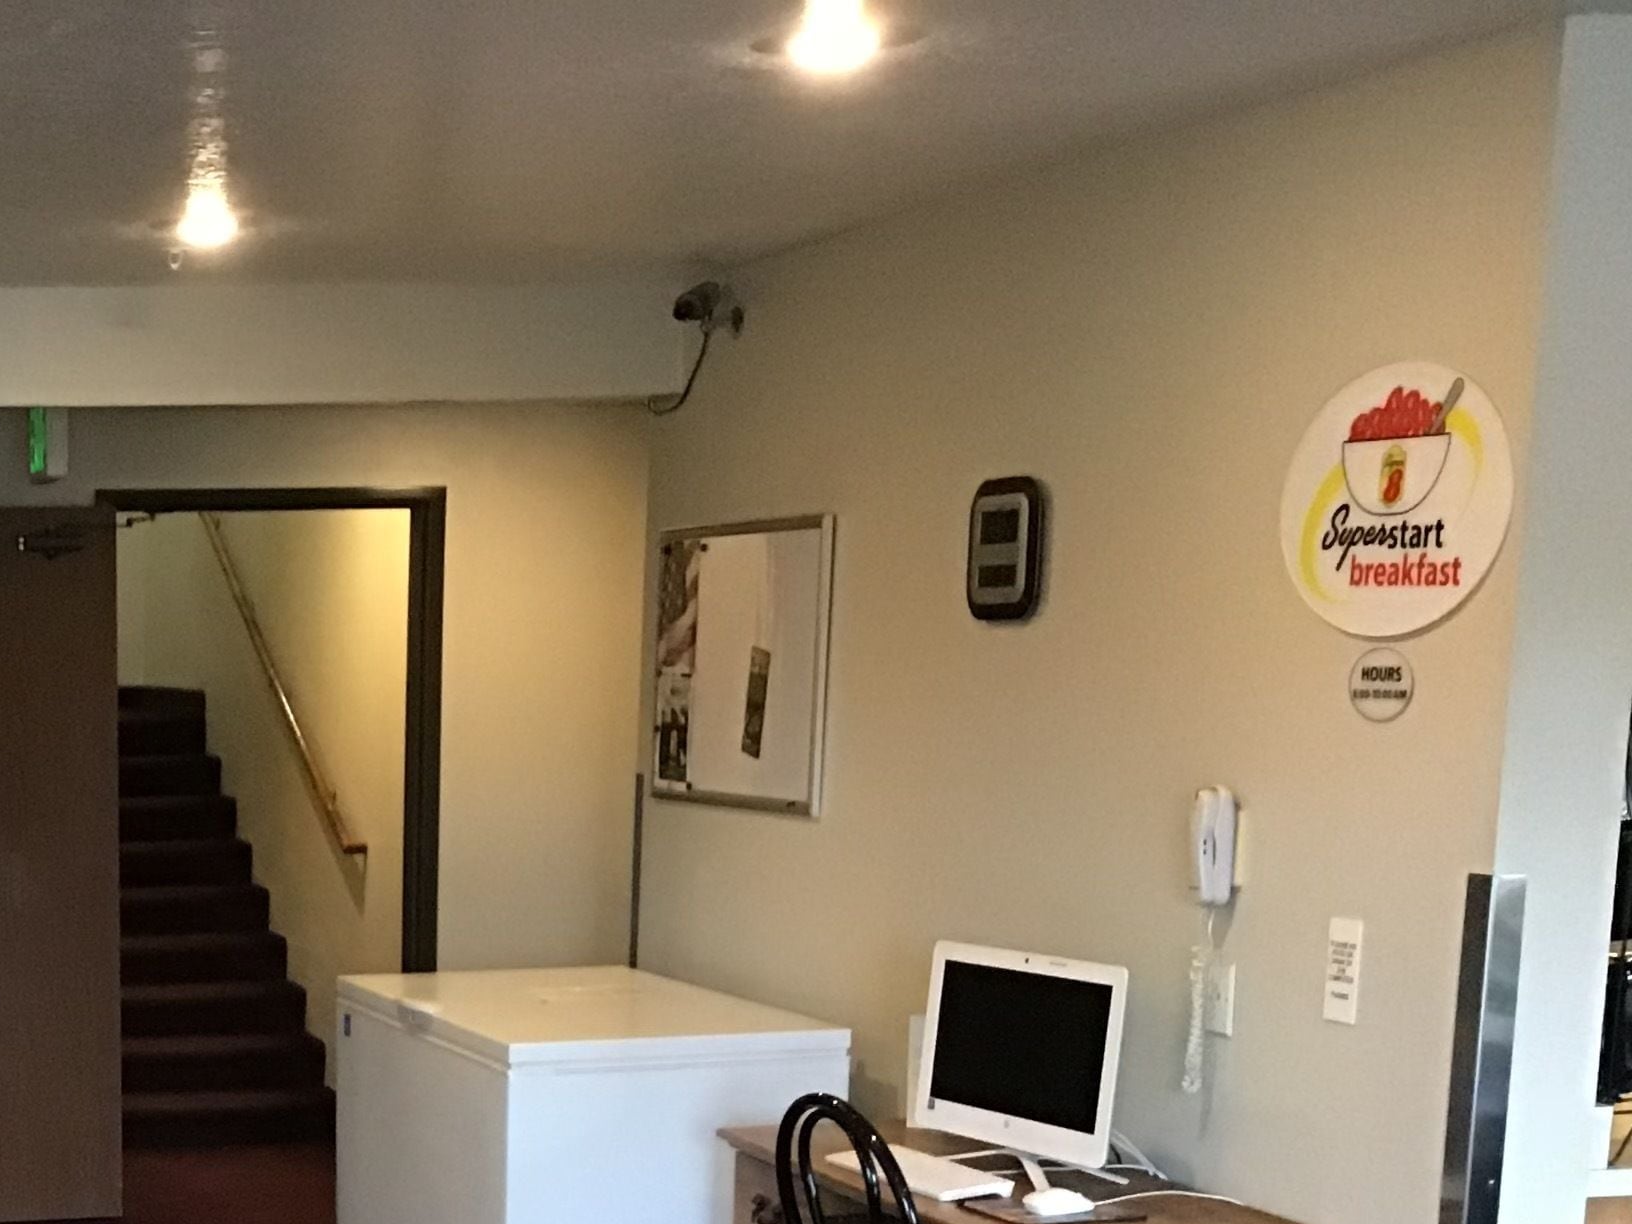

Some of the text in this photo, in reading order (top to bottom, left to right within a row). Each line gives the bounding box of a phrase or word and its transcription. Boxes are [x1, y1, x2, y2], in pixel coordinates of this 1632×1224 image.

[1321, 503, 1445, 571] Superstart
[1349, 552, 1462, 587] breakfast
[1361, 666, 1403, 682] HOURS
